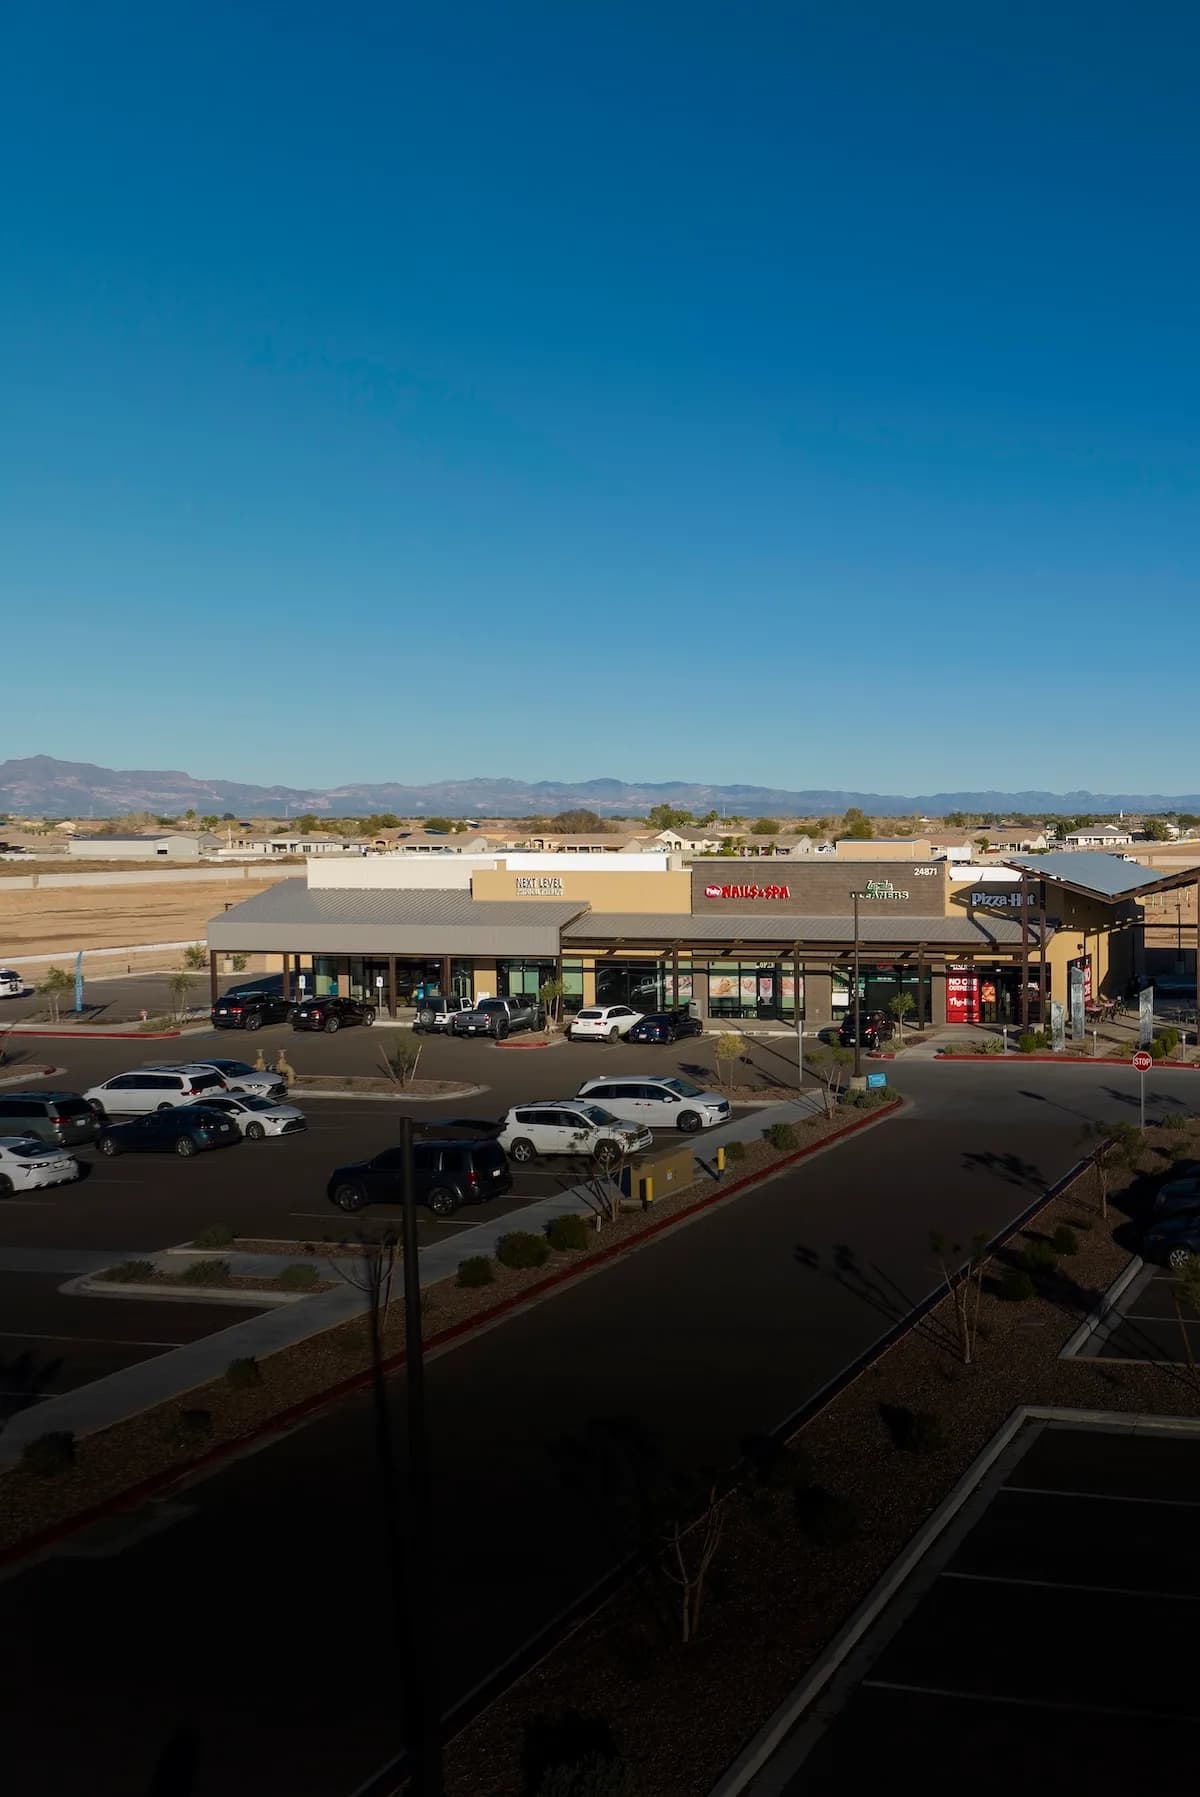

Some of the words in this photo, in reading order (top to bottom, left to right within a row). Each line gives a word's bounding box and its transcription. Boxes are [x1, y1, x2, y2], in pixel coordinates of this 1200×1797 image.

[914, 868, 937, 876] 24871
[515, 877, 537, 888] NEXT
[539, 877, 563, 888] LEVEL
[721, 885, 758, 899] NAILS
[767, 885, 790, 899] SPA
[971, 893, 1008, 907] Pizza
[948, 978, 961, 986] NO
[1135, 1058, 1150, 1066] STOP
